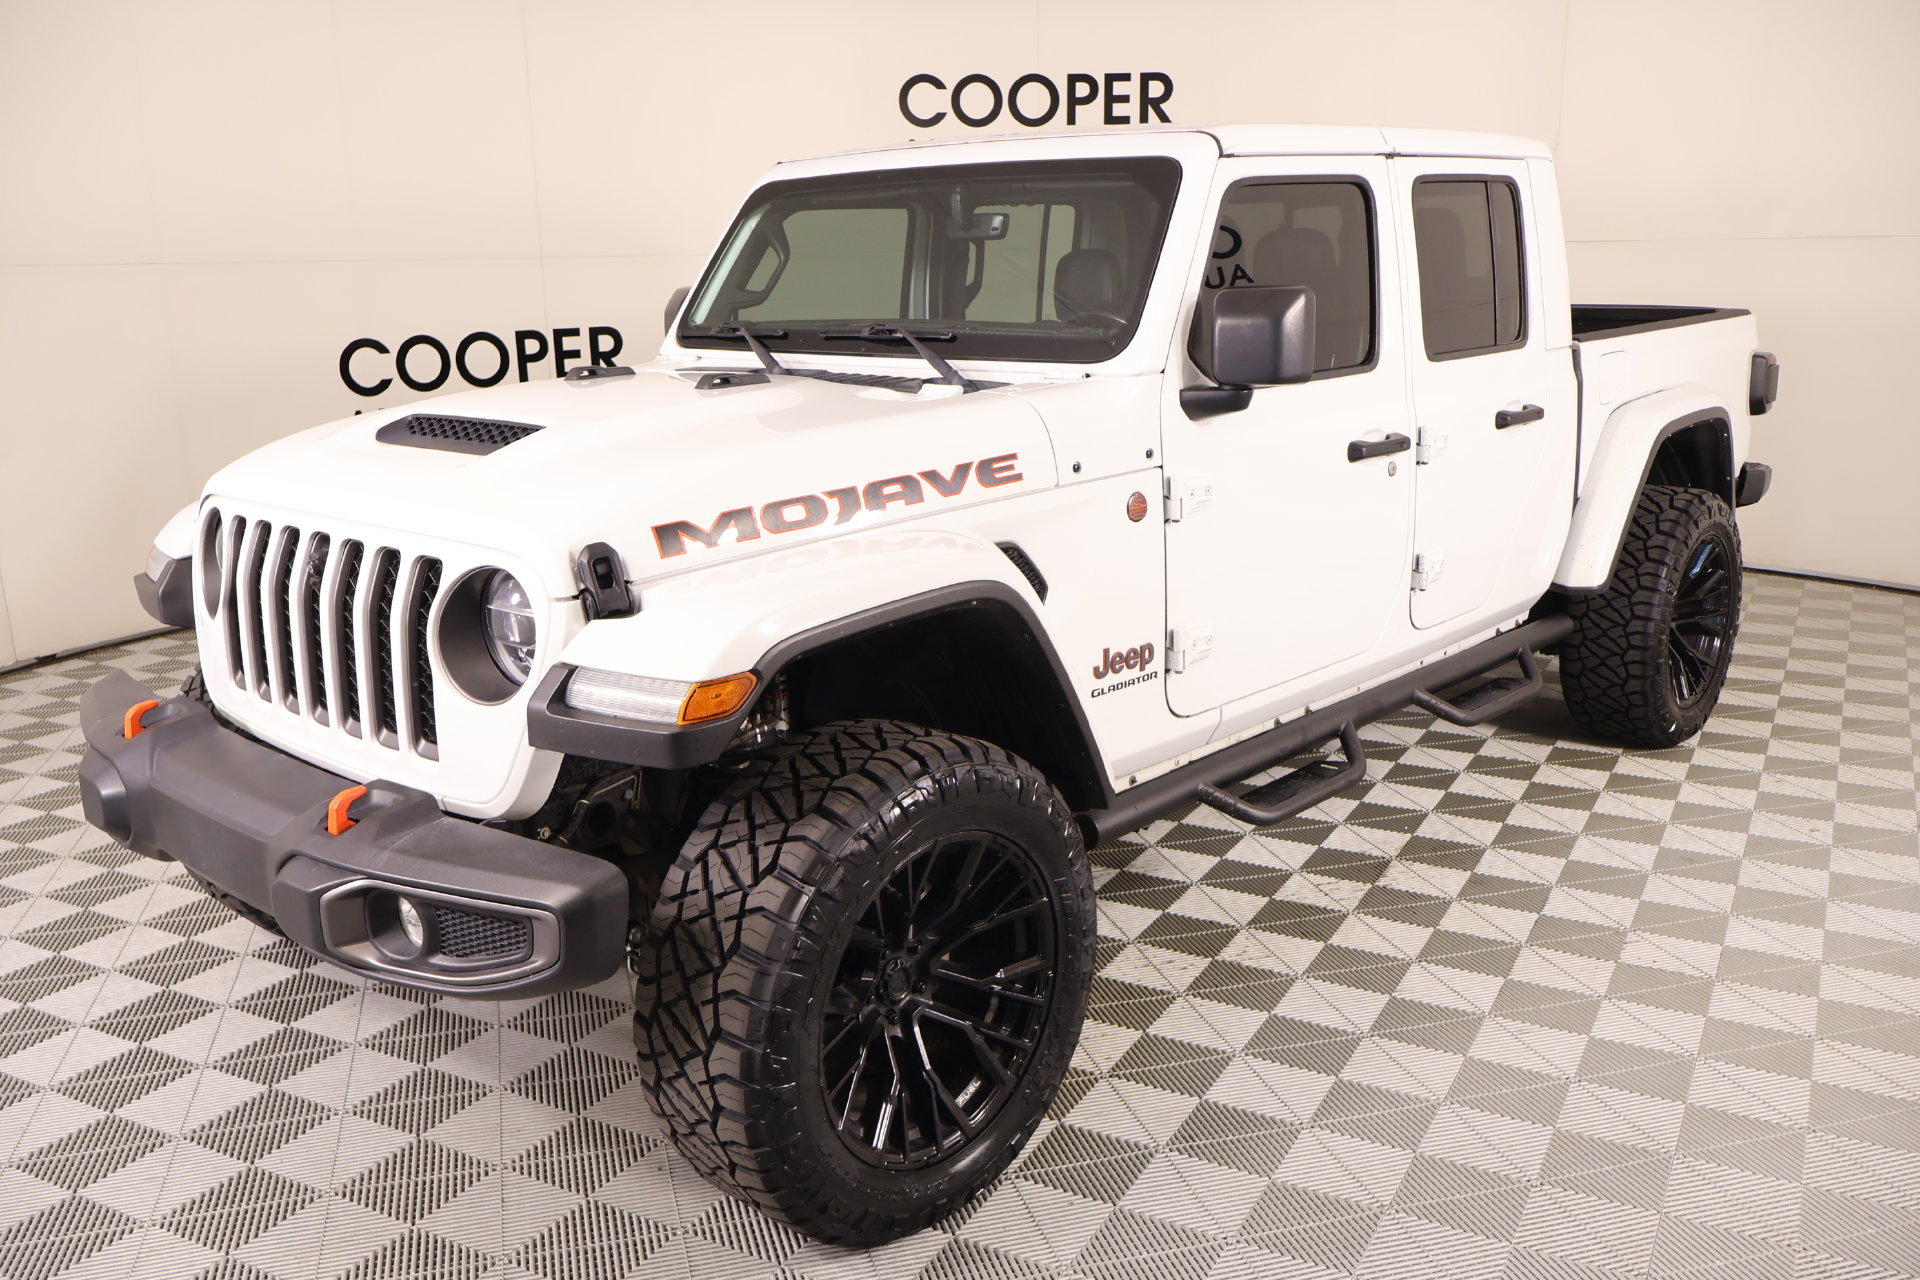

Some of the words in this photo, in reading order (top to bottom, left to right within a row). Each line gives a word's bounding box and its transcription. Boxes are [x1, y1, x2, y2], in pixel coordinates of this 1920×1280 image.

[899, 72, 1173, 127] COOPER
[339, 326, 623, 397] COOPER
[651, 452, 1023, 559] MOJAVE
[1093, 642, 1154, 680] Jeep
[1091, 671, 1158, 698] GLADIATOR
[957, 1080, 981, 1105] FUEL
